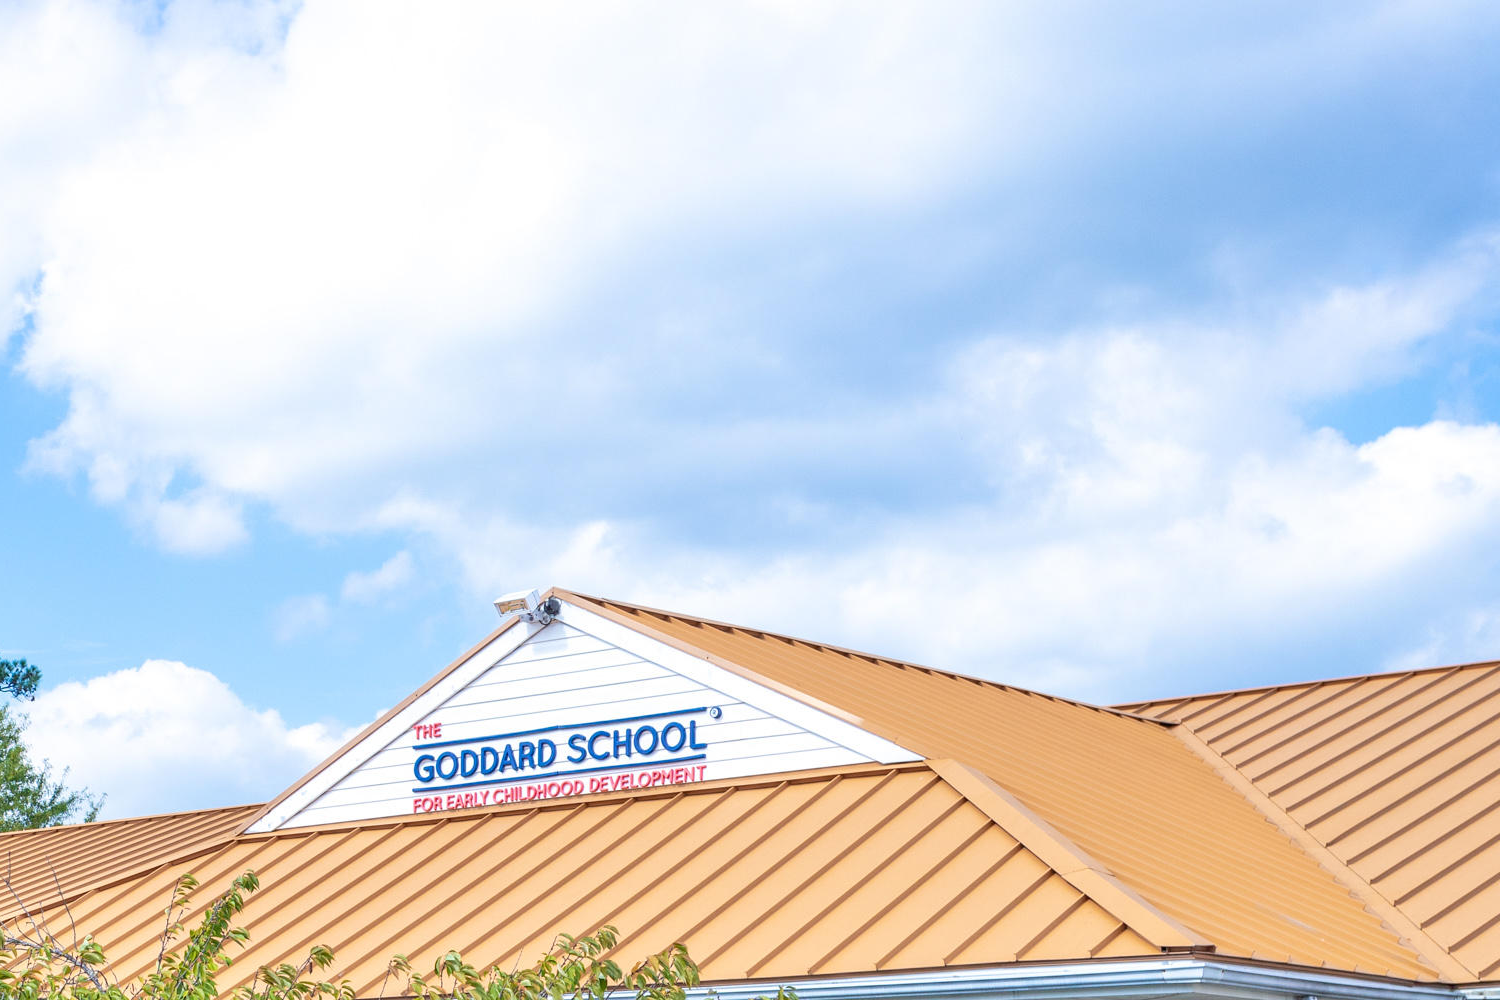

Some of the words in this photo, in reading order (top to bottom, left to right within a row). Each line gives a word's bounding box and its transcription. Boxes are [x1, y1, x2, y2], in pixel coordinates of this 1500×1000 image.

[412, 723, 442, 740] THE
[413, 739, 557, 783] GODDARD
[566, 720, 708, 763] SCHOOL
[413, 796, 443, 813] FOR
[446, 790, 490, 811] EARLY
[492, 781, 585, 805] CHILDHOOD
[588, 765, 707, 793] DEVELOPMENT
